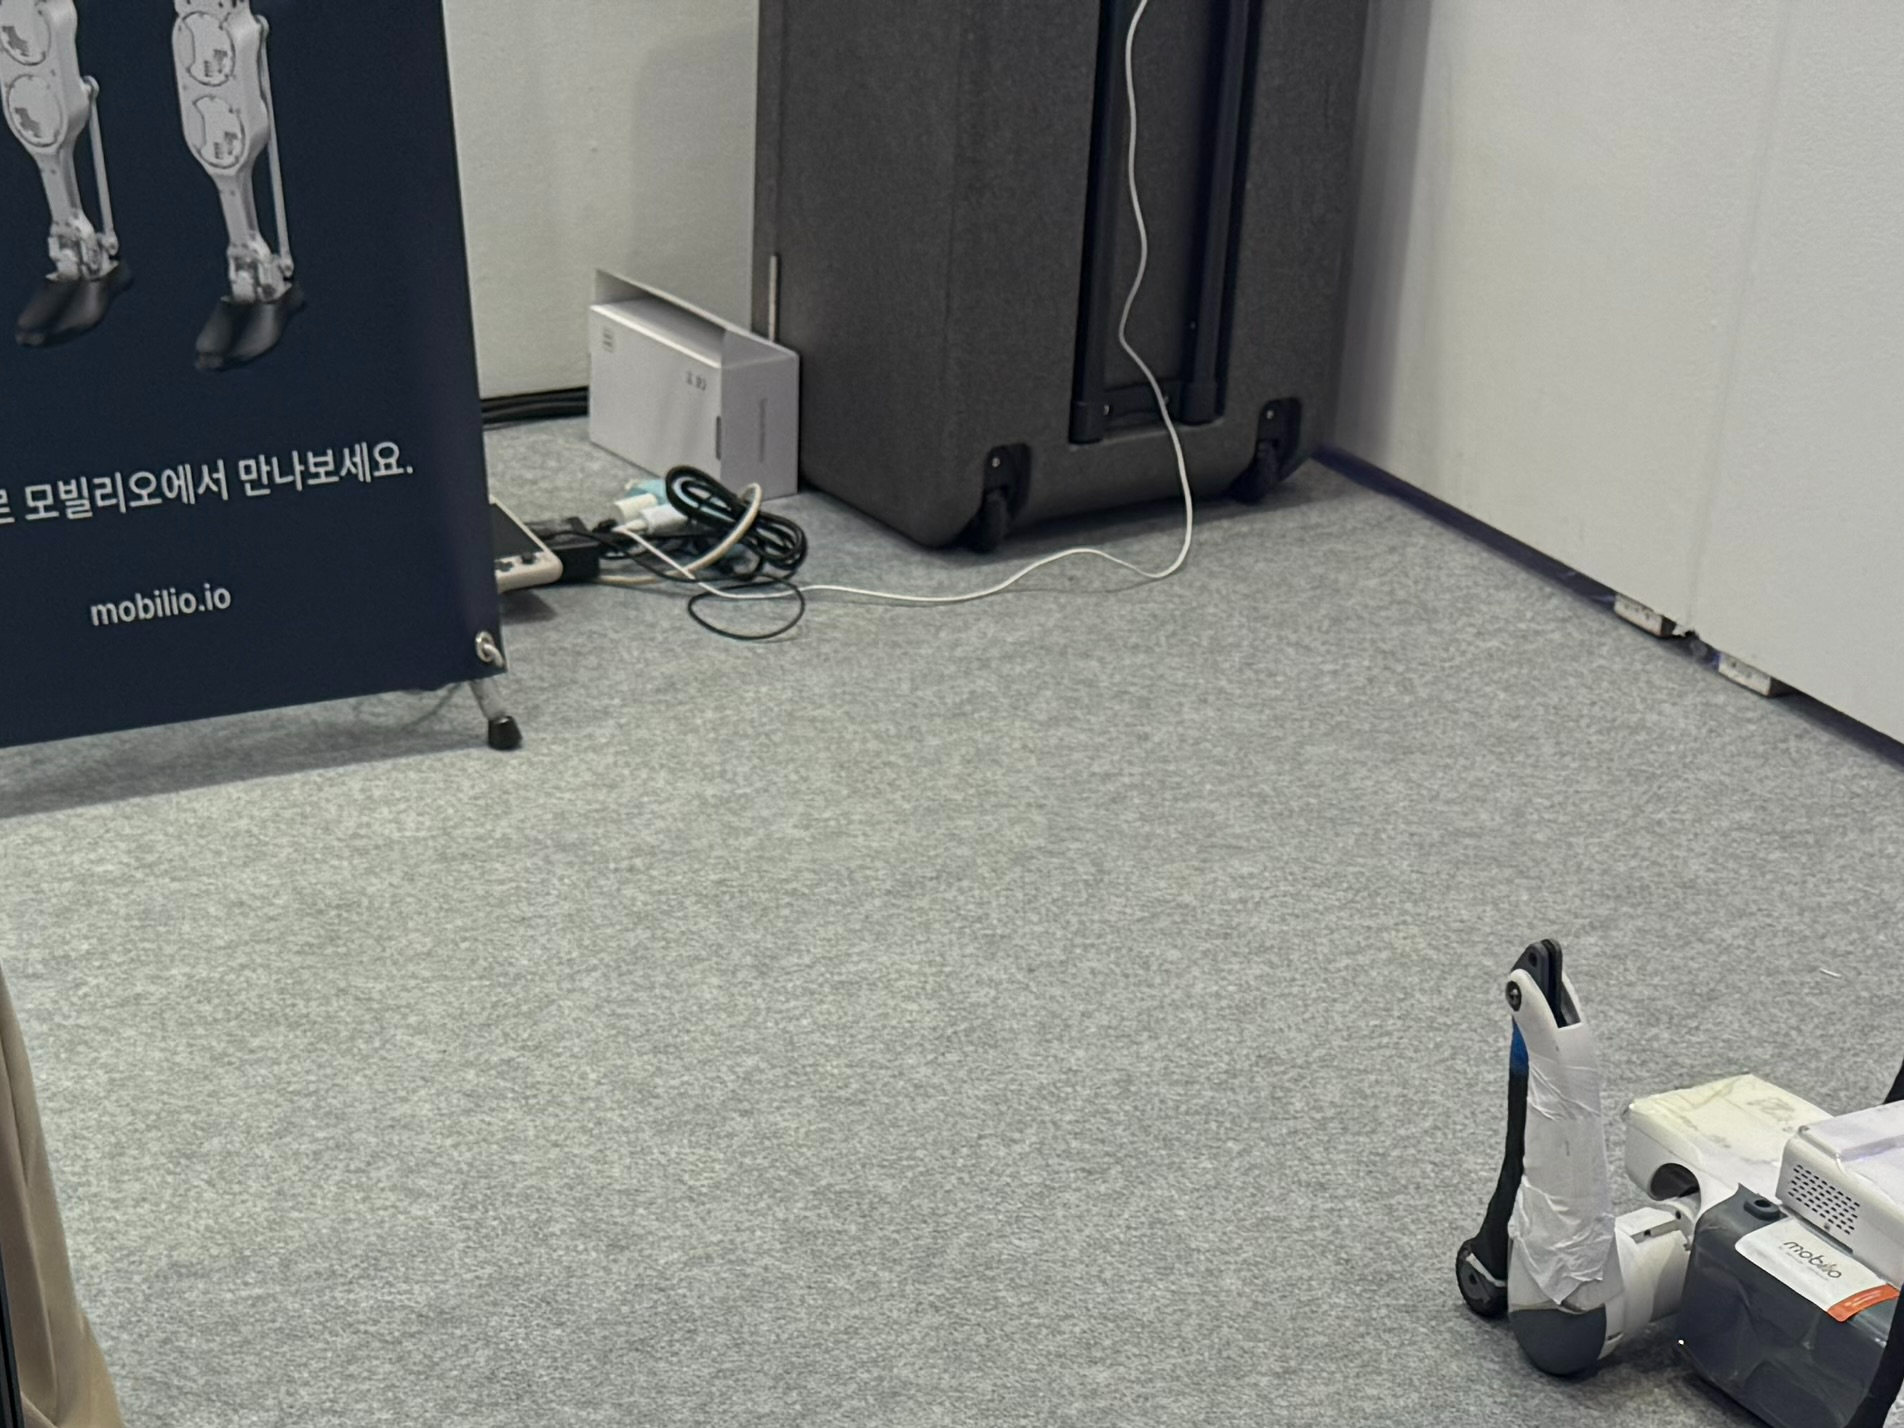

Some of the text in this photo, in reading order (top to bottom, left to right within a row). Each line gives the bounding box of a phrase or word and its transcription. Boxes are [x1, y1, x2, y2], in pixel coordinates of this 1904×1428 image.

[25, 459, 229, 521] 모빌리오에서
[238, 441, 414, 497] 만나보세요.
[91, 583, 231, 627] mobilio.io
